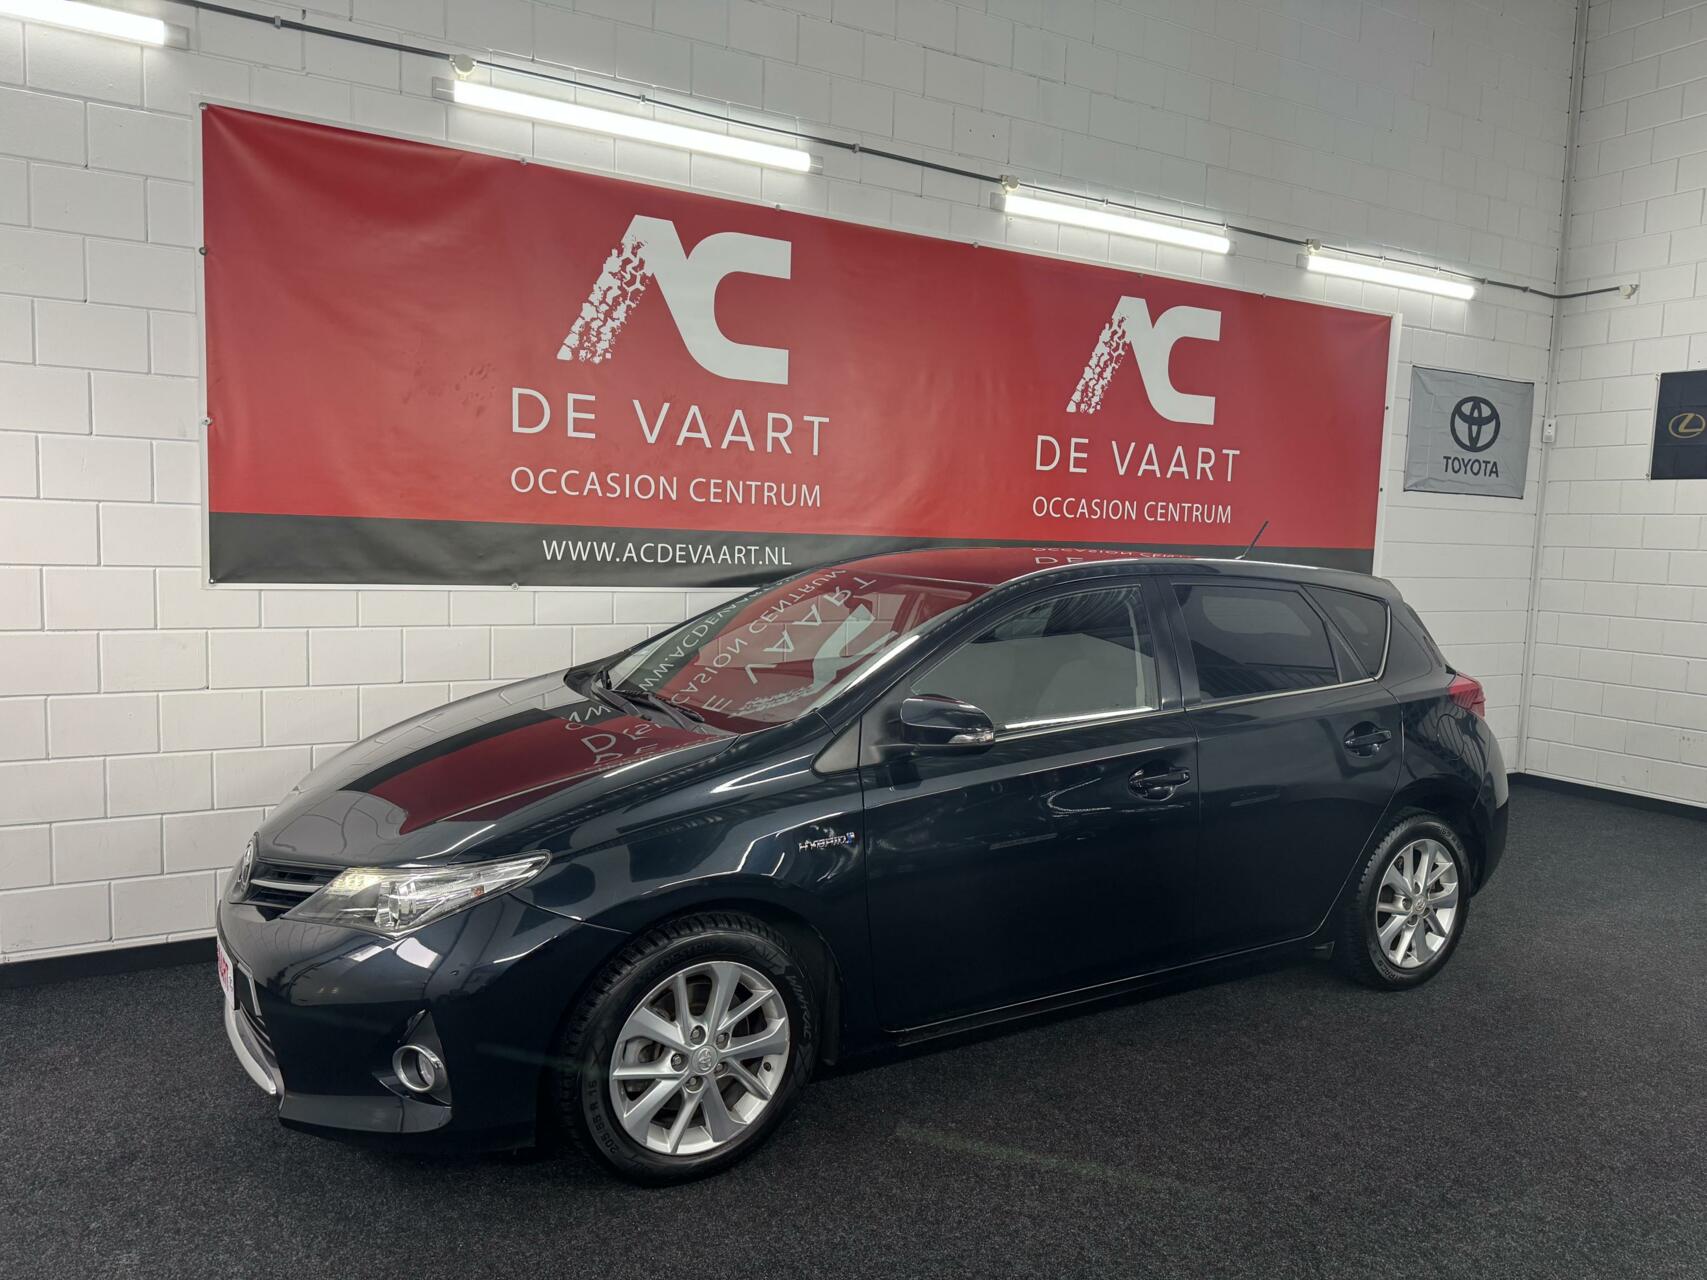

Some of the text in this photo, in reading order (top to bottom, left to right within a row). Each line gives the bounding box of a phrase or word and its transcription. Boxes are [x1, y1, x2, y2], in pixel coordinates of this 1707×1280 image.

[511, 387, 830, 456] DE VAART
[1035, 434, 1240, 482] DE VAART
[1443, 455, 1499, 478] TOYOTA
[510, 466, 822, 507] OCCASION CENTRUM
[1032, 495, 1232, 524] OCCASION CENTRUM
[542, 539, 792, 566] WWW.ACDEVAART.NL
